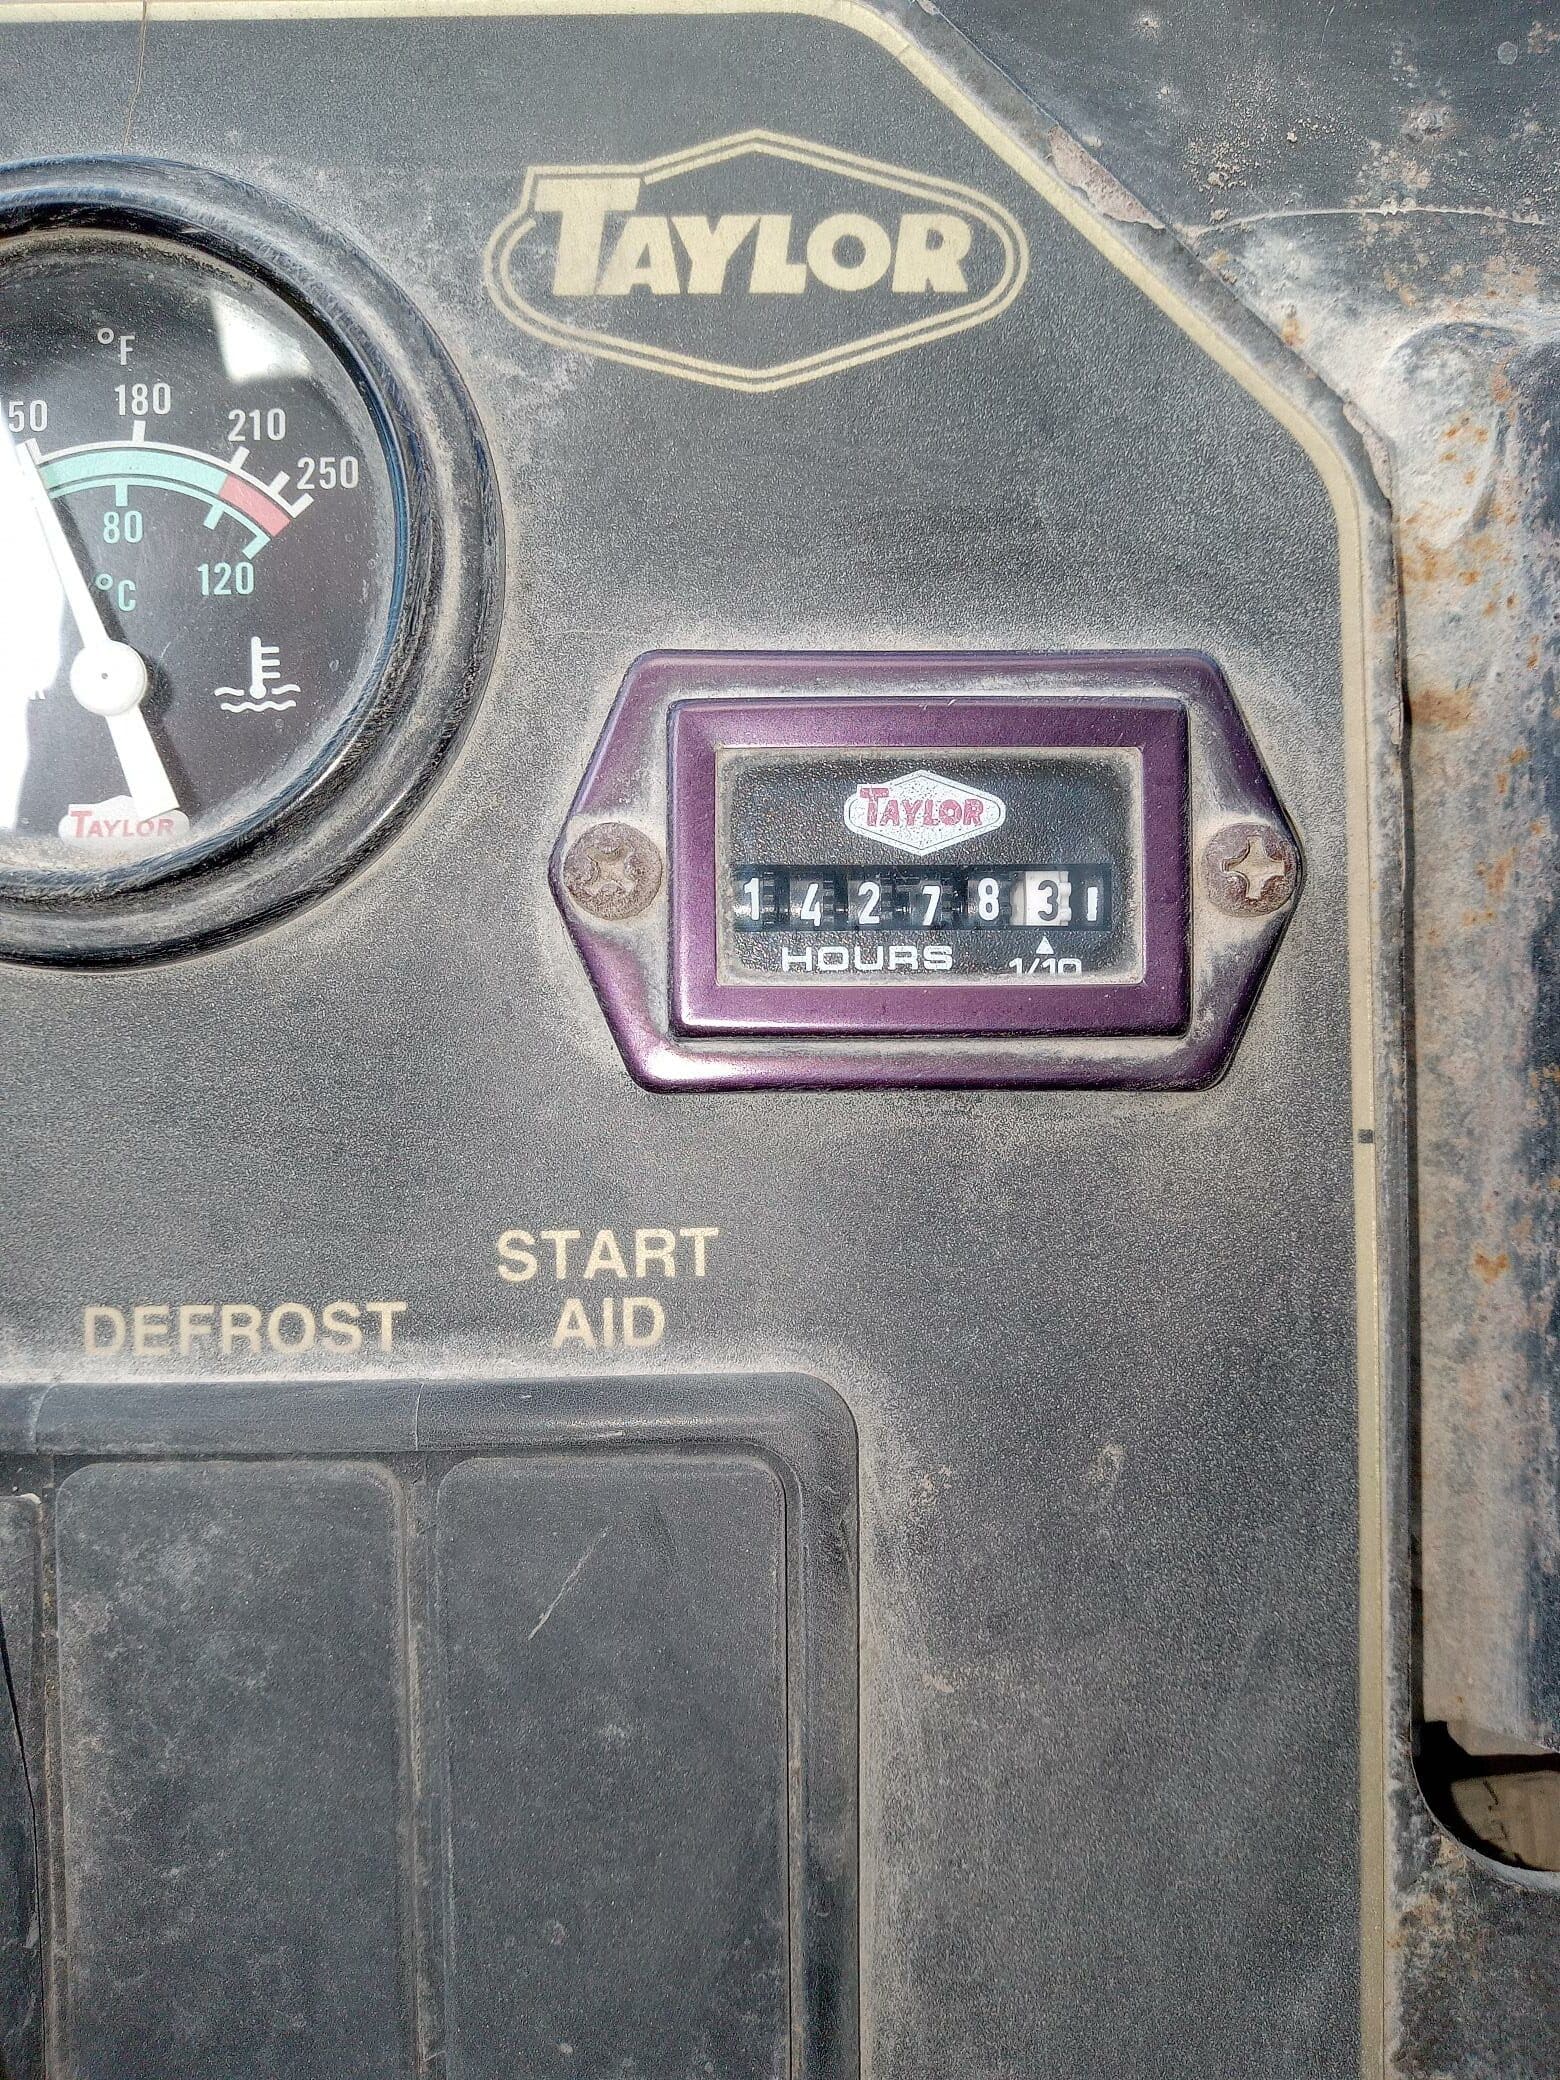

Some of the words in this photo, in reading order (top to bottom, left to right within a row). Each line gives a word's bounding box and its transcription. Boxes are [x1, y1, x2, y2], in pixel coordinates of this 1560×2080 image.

[533, 176, 971, 296] TAYLOR
[1, 399, 48, 433] 50
[114, 382, 172, 416] 180
[226, 408, 287, 442] 210
[296, 456, 360, 490] 250
[102, 510, 144, 544] 80
[197, 561, 255, 597] 120
[859, 786, 985, 828] TAYLOR
[70, 810, 175, 839] TAYLOR
[781, 944, 954, 973] HOURS
[496, 1226, 722, 1284] START
[82, 1300, 408, 1358] DEFROST
[551, 1296, 666, 1351] AID
